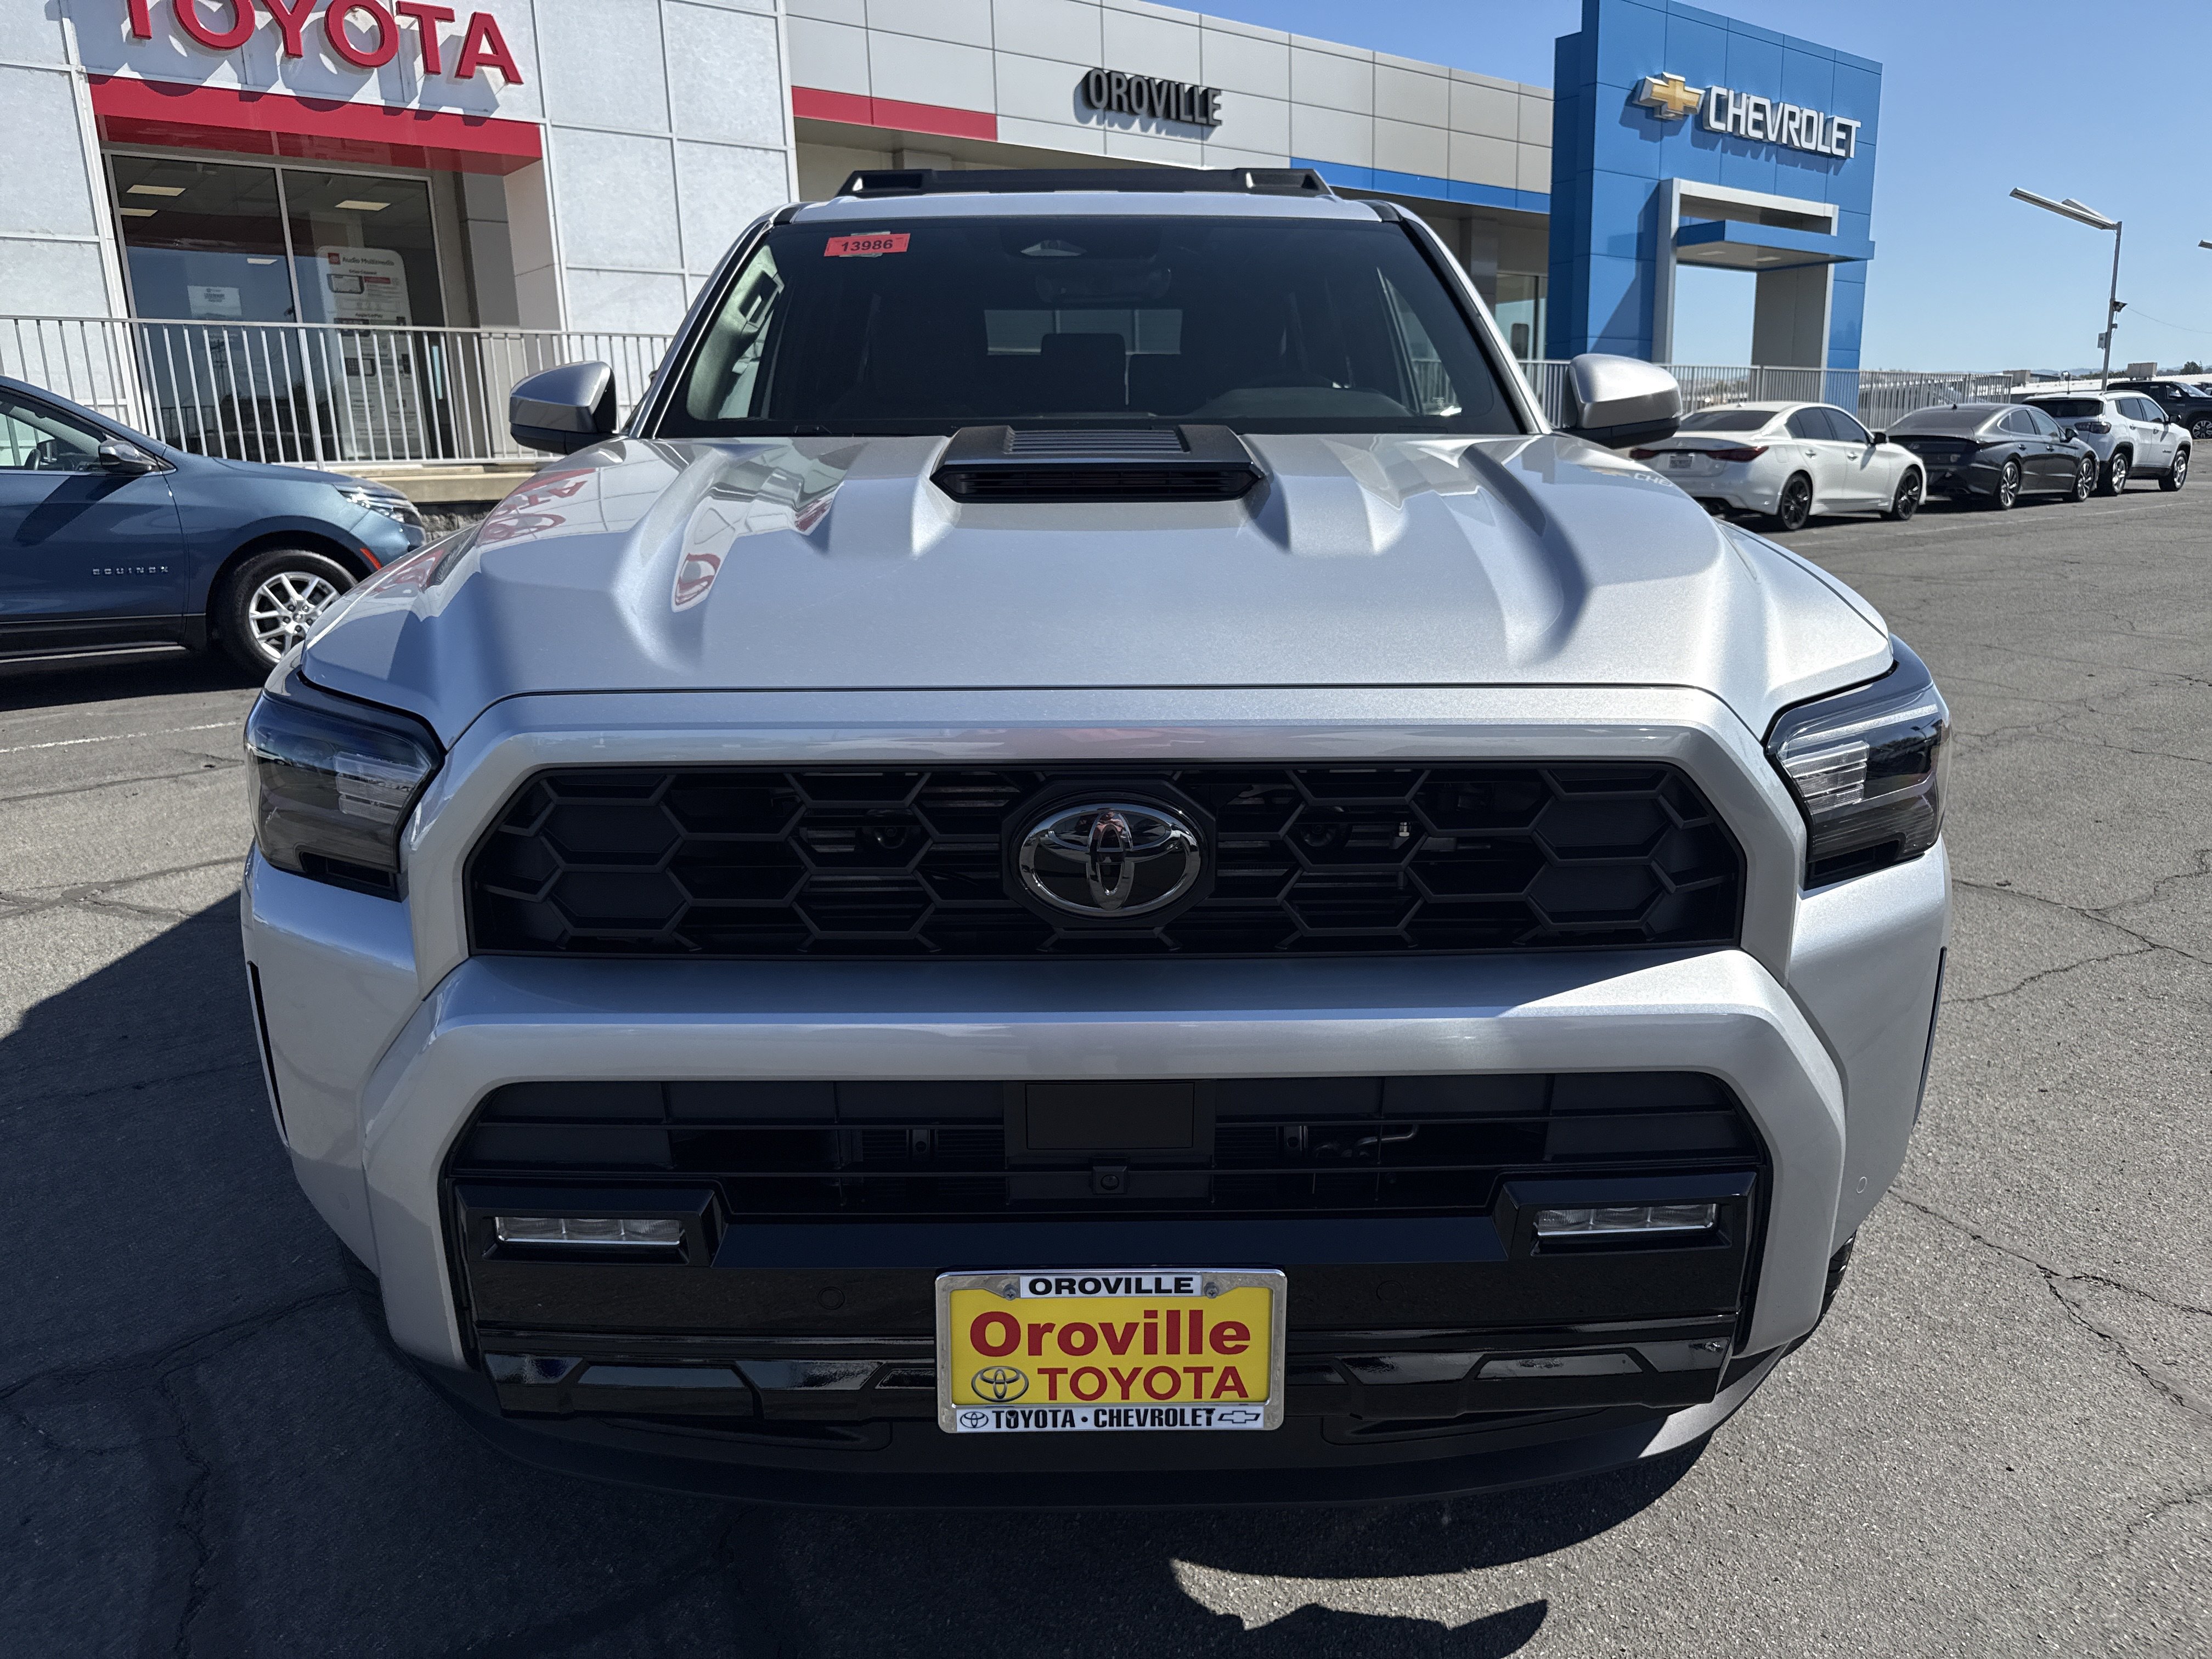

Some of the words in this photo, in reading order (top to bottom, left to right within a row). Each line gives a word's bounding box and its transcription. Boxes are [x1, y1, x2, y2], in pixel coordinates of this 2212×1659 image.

[1088, 67, 1222, 126] OROVILLE
[1706, 86, 1861, 159] CHEVROLET
[842, 239, 893, 252] 13986
[1028, 1277, 1194, 1295] OROVILLE
[970, 1310, 1251, 1357] Oroville
[1037, 1366, 1249, 1401] TOYOTA
[991, 1409, 1076, 1429] TOYOTA
[1094, 1408, 1216, 1428] CHEVROLET
